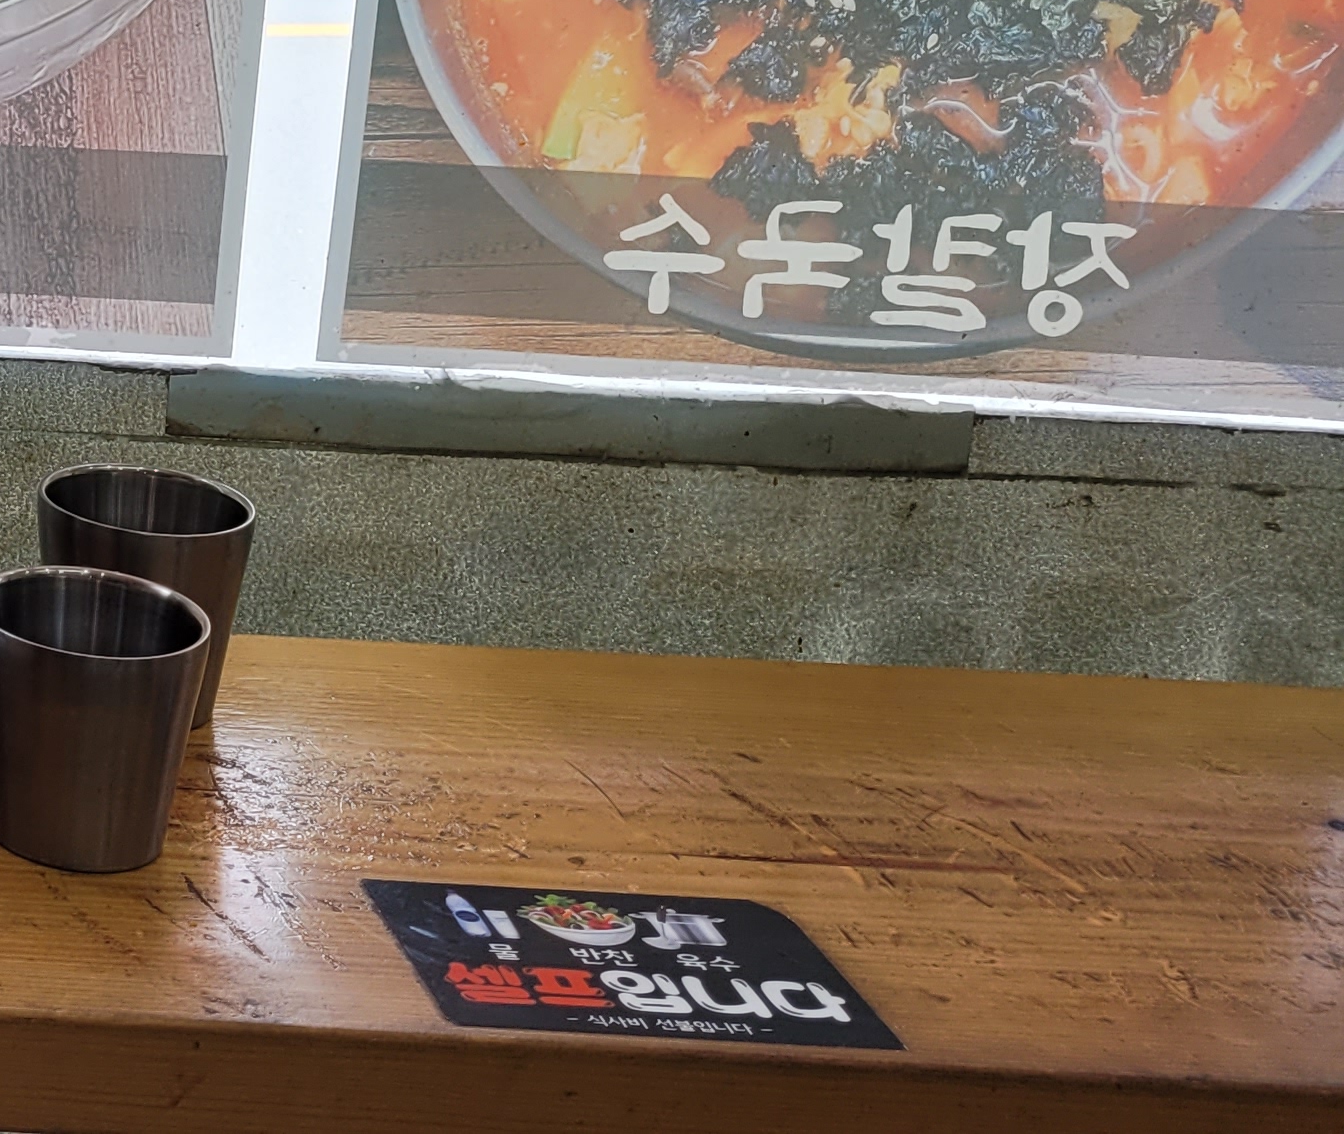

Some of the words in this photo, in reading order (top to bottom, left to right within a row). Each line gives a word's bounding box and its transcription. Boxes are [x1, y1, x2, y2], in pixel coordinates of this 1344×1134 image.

[486, 942, 522, 961] 물
[568, 946, 638, 968] 반찬
[675, 953, 741, 973] 육수
[444, 961, 853, 1024] 셀프입니다
[586, 1014, 649, 1031] 식사비
[655, 1017, 754, 1036] 선불입니다
